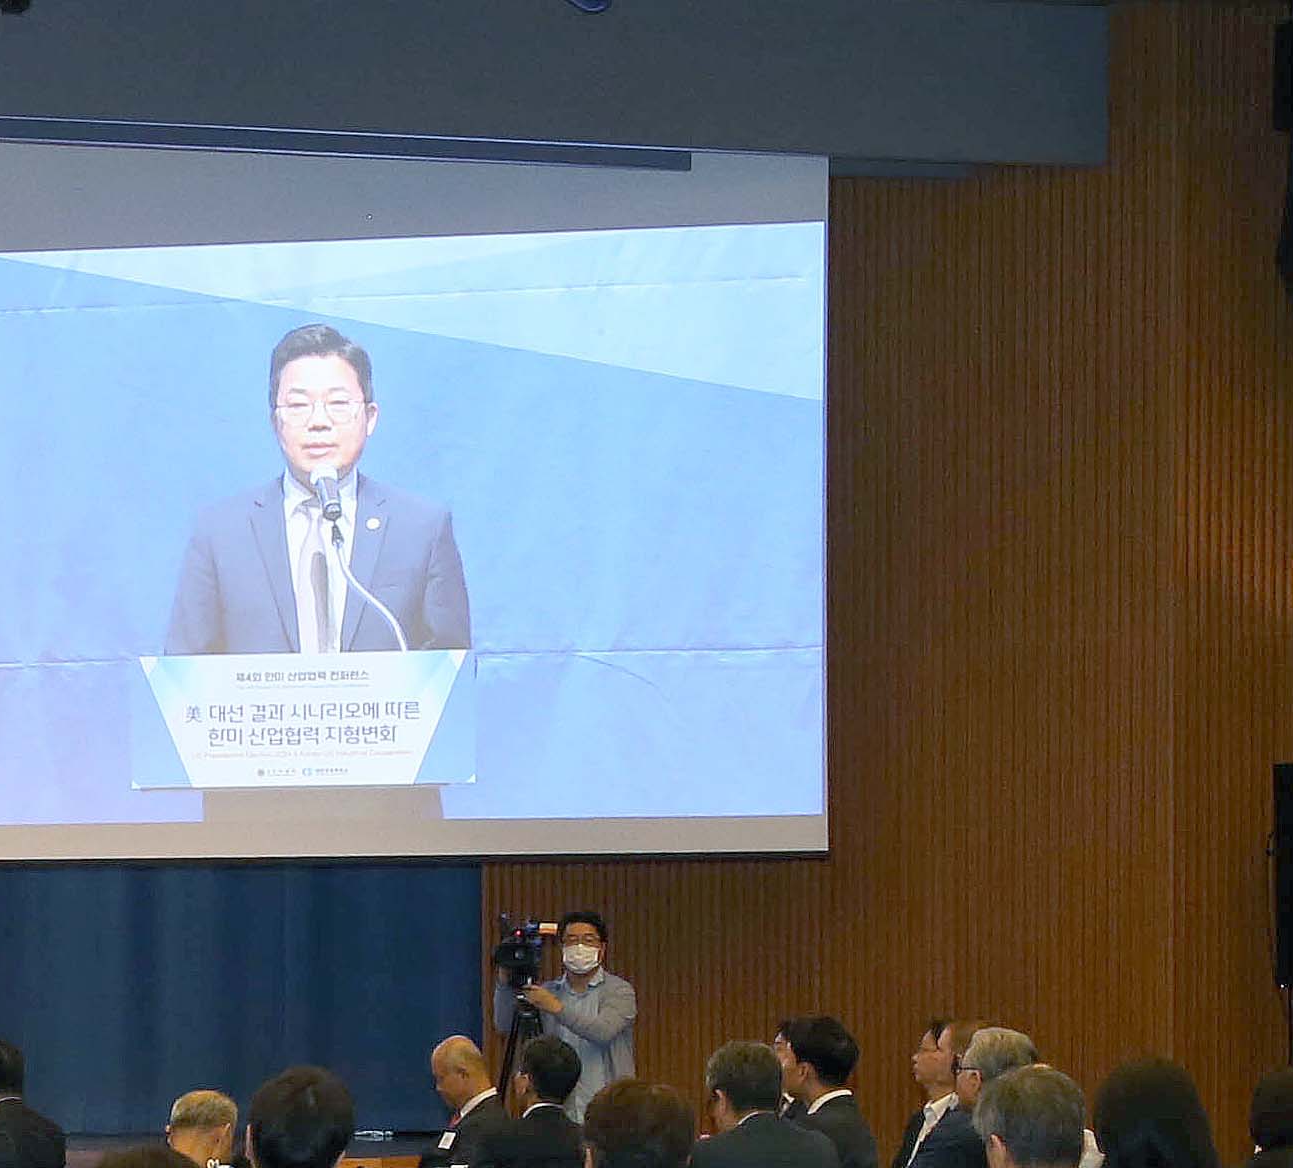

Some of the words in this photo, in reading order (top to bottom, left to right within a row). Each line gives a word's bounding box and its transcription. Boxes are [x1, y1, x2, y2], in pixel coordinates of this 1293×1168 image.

[209, 704, 244, 724] 대선
[251, 704, 285, 723] 결과
[291, 702, 379, 721] 시나리오에
[385, 701, 420, 720] 따른
[208, 727, 243, 748] 한미
[248, 726, 319, 747] 산업협력
[325, 724, 397, 746] 지형변화
